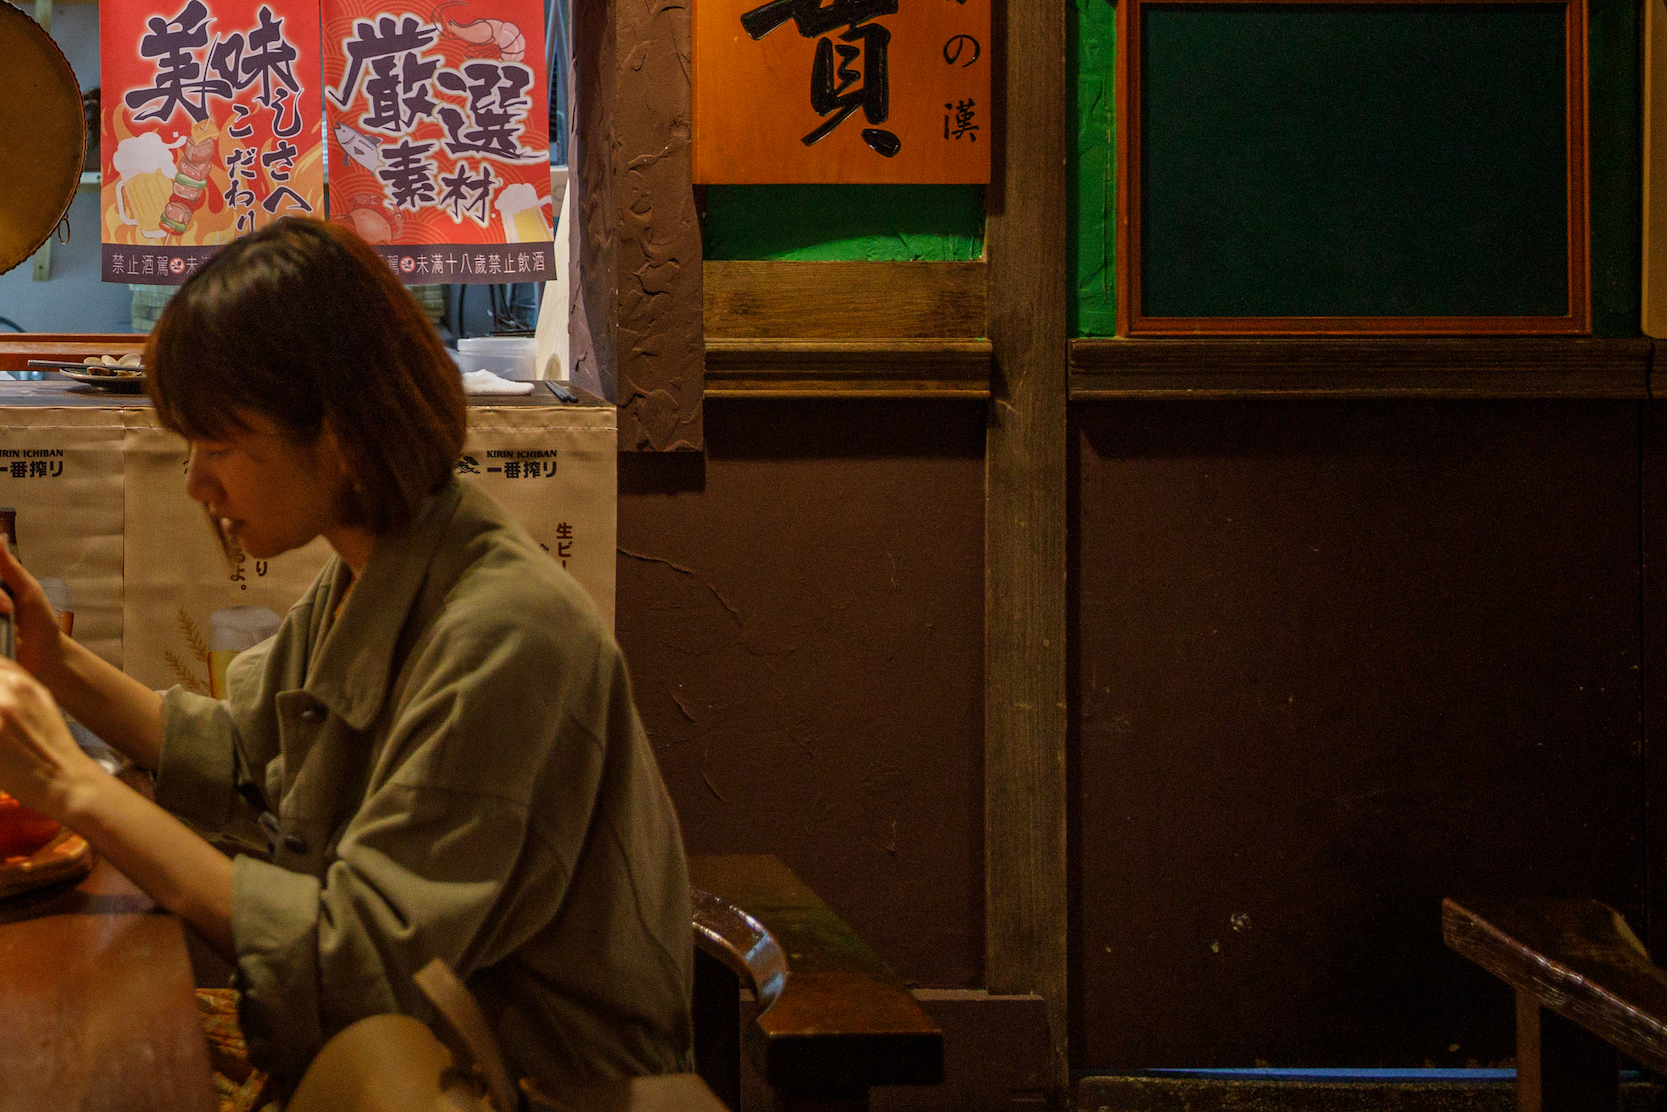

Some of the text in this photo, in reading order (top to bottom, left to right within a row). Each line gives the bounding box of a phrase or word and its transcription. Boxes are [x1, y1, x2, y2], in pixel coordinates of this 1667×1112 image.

[112, 253, 169, 277] 禁止酒駕
[416, 251, 546, 275] 未滿十八歲禁止飲酒
[23, 450, 63, 458] ICHIBAN
[487, 450, 557, 458] KIRIN ICHIBAN
[487, 461, 557, 478] 一番搾り
